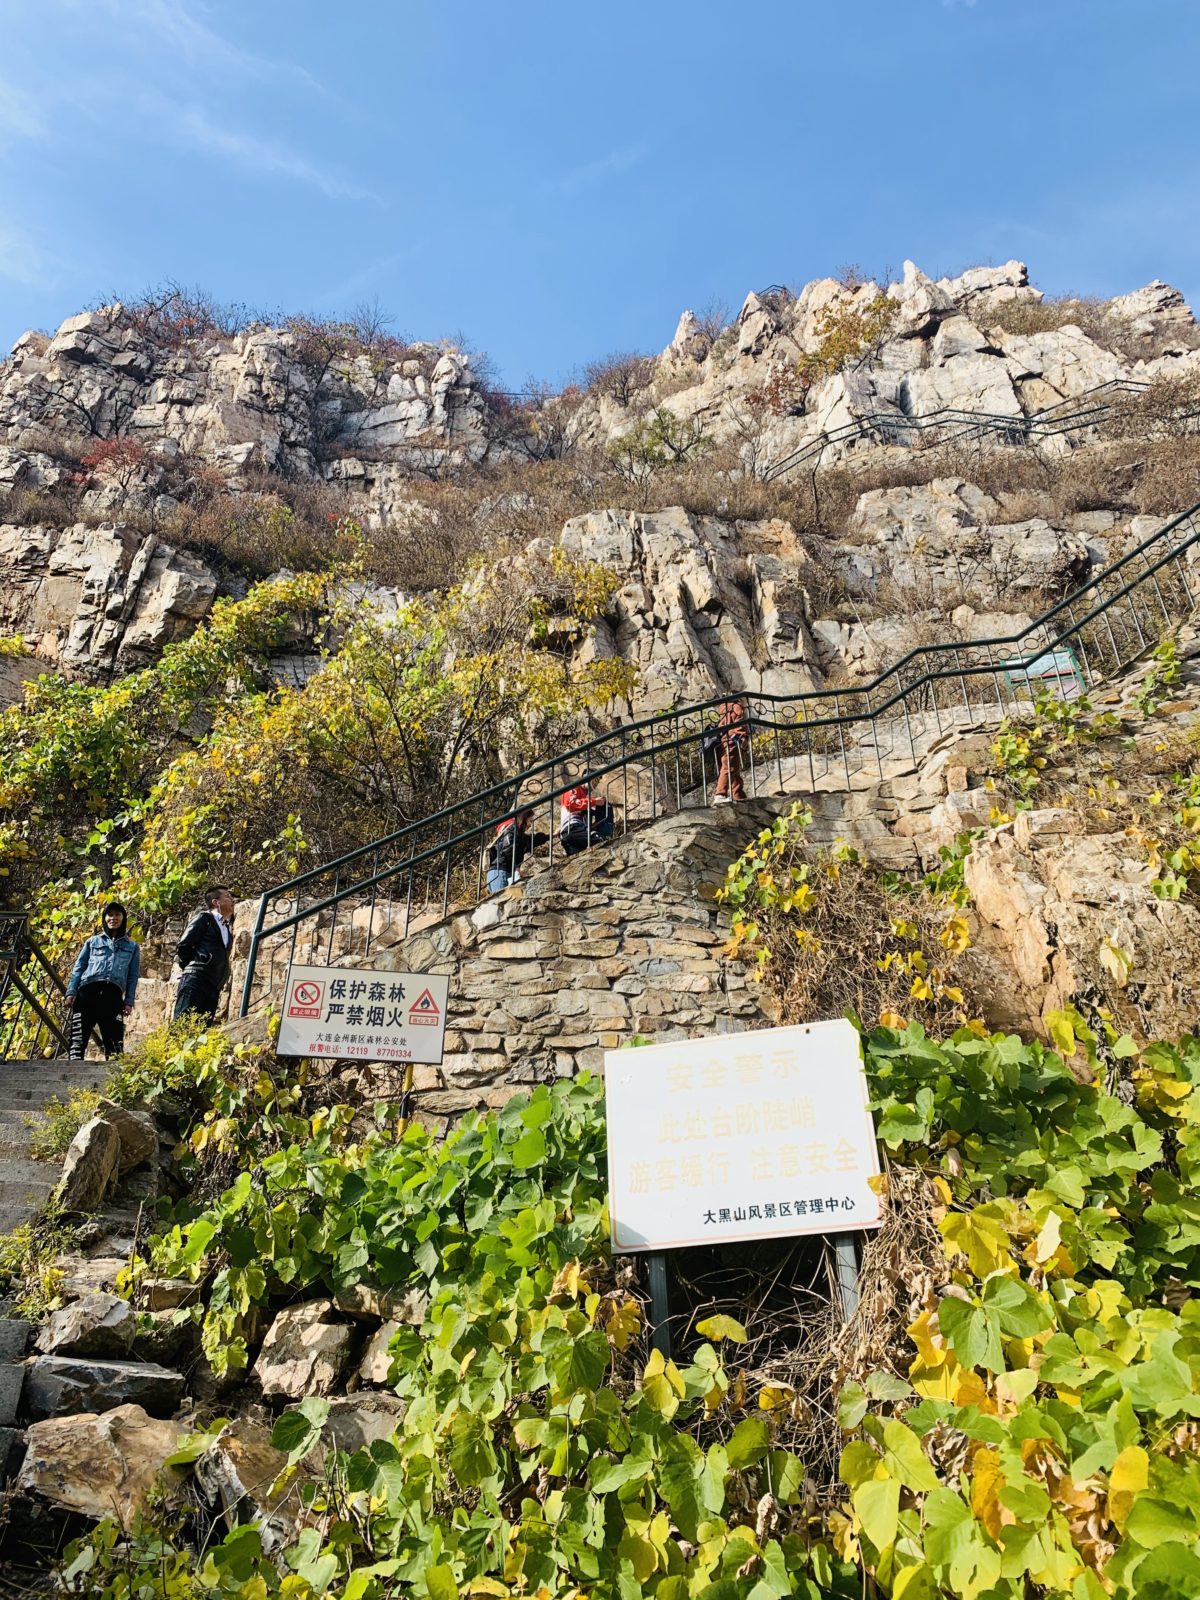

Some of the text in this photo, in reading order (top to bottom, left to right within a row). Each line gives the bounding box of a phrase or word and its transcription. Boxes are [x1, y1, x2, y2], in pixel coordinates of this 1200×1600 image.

[329, 978, 406, 1003] 保护森林
[324, 1003, 404, 1028] 严禁烟火
[315, 1032, 407, 1046] 大连金州新区森林公安处
[346, 1046, 369, 1056] 12119
[376, 1049, 412, 1059] 87701334
[666, 1049, 800, 1093] 安全警示
[657, 1095, 818, 1145] 此处台阶陡峭
[628, 1137, 859, 1194] 游客缓行 注意安全
[703, 1195, 857, 1225] 大黑山风景区管理中心
